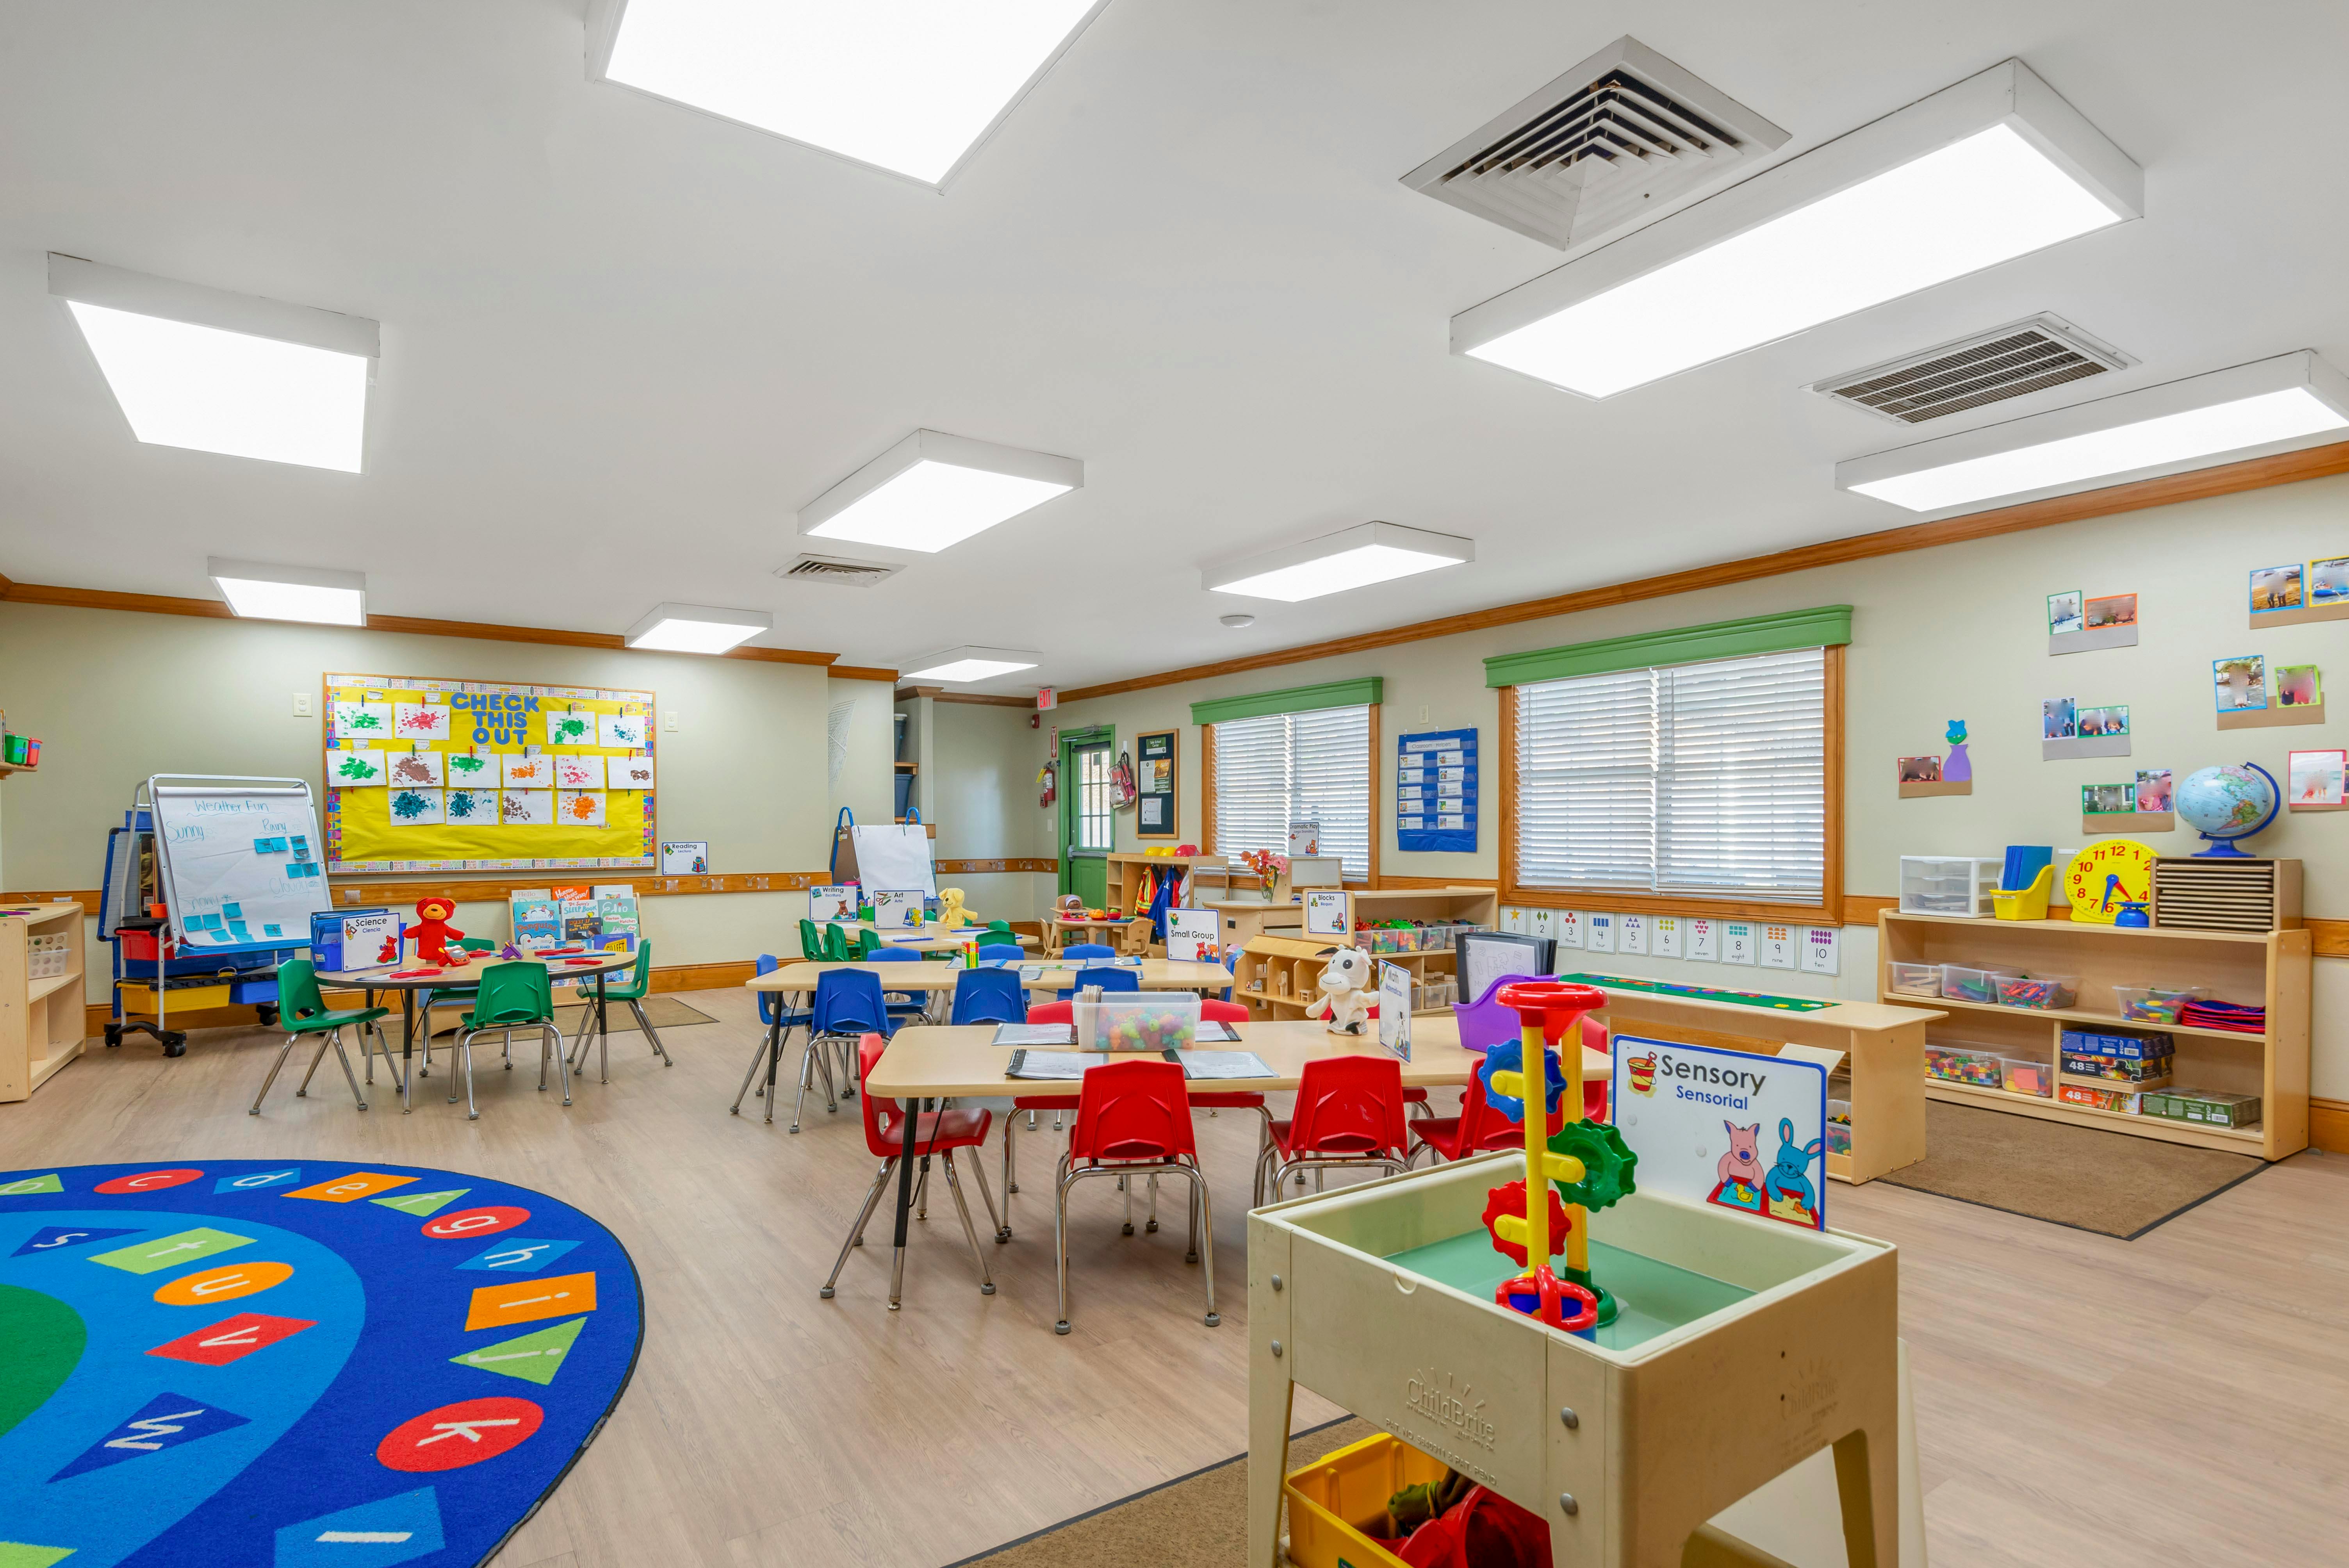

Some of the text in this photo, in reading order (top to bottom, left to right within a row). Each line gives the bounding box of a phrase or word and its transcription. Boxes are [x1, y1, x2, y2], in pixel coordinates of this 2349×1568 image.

[450, 692, 540, 713] CHECK
[1039, 690, 1050, 708] EXIT
[472, 711, 527, 729] THIS
[472, 727, 528, 745] OUT
[195, 800, 269, 812] Weather Fun
[166, 818, 287, 841] Sunny Rainy
[2093, 850, 2105, 860] 11
[2110, 846, 2126, 856] 12
[2133, 850, 2139, 860] 1
[2078, 862, 2093, 872] 10
[2143, 861, 2150, 871] 2
[2073, 874, 2082, 884] 9
[269, 877, 310, 895] Cloudy
[555, 888, 574, 899] HORTON
[564, 891, 578, 900] HEARS
[574, 889, 588, 900] WHO!
[2077, 888, 2086, 898] 8
[2139, 891, 2148, 901] 4
[177, 892, 219, 912] Snowy
[2089, 899, 2098, 909] 7
[2105, 902, 2114, 913] 6
[356, 918, 387, 927] Science
[517, 923, 557, 933] Penguins
[1540, 925, 1545, 933] 2
[1568, 927, 1573, 935] 3
[1192, 931, 1214, 941] Group
[1598, 931, 1603, 939] 4
[1631, 932, 1636, 941] 5
[1664, 935, 1669, 944] 6
[1698, 938, 1704, 947] 7
[1736, 941, 1741, 950] 8
[1775, 944, 1781, 953] 9
[1816, 948, 1827, 959] 10
[1388, 968, 1399, 984] Math
[2069, 1061, 2085, 1070] 48
[1661, 1055, 1766, 1096] Sensory
[1677, 1085, 1748, 1110] Sensorial
[2066, 1090, 2081, 1100] 48
[128, 1175, 173, 1186] c
[233, 1172, 293, 1187] d
[326, 1181, 369, 1195] e
[396, 1192, 455, 1207] f
[432, 1215, 499, 1234] g
[32, 1233, 89, 1248] s
[147, 1240, 207, 1258] t
[485, 1244, 550, 1268] h
[191, 1273, 250, 1296] u
[499, 1291, 570, 1308] i
[469, 1348, 561, 1363] j
[1407, 1379, 1495, 1443] ChildBrite
[1386, 1418, 1401, 1434] PAT.
[1403, 1427, 1415, 1440] NO.
[1448, 1452, 1453, 1462] &
[1454, 1455, 1472, 1472] PAT.
[1474, 1465, 1499, 1488] PEND.
